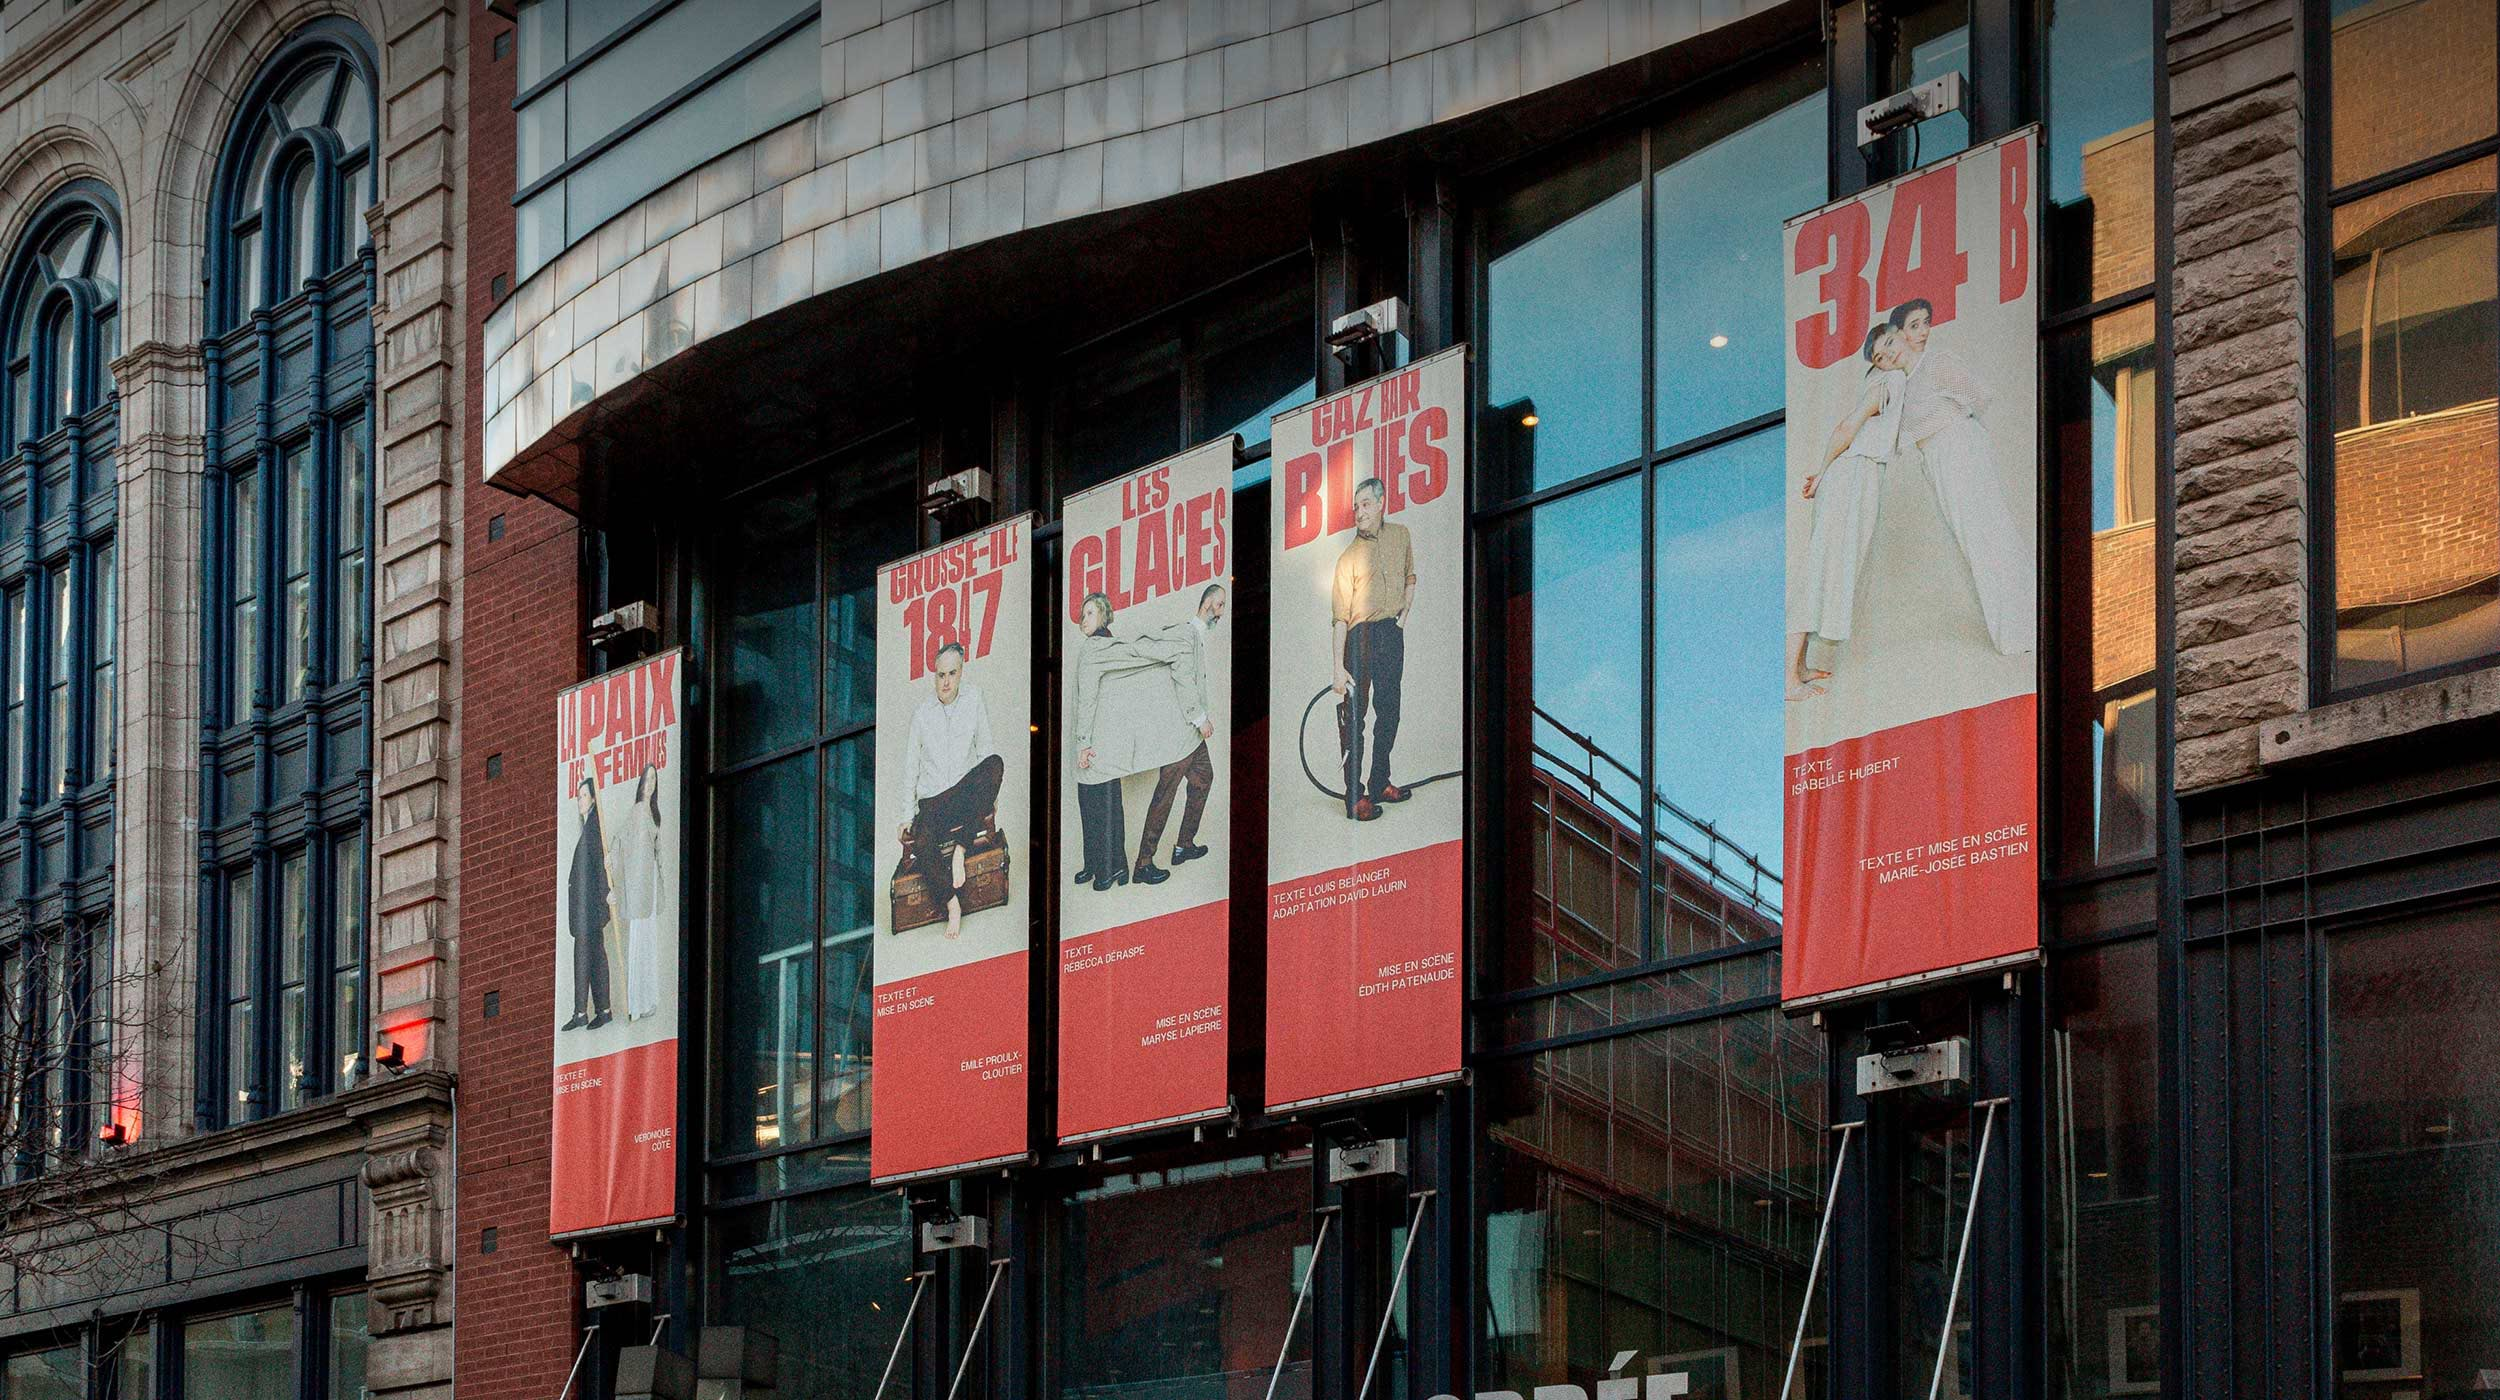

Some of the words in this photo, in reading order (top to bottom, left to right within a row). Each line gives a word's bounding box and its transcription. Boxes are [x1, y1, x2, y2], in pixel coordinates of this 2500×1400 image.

[1794, 163, 1969, 369] 34
[1999, 138, 2029, 305] B
[1311, 386, 1374, 448] GAZ
[1380, 368, 1421, 423] BAR
[1284, 406, 1449, 551] BLUES
[1122, 466, 1170, 522] LES
[1069, 487, 1226, 625] GLACES
[903, 568, 1003, 681] 1847
[560, 691, 577, 763] LA
[580, 654, 677, 755] PAIX
[568, 757, 585, 800] DES
[593, 729, 668, 791] FEMMES
[1791, 771, 1846, 796] ISABELLE
[1849, 756, 1901, 781] HUBERT
[1793, 758, 1833, 779] TEXTE
[1859, 851, 1903, 872] TEXTE
[1906, 846, 1925, 862] ET
[1928, 838, 1959, 857] MISE
[1962, 834, 1981, 849] EN
[1984, 823, 2029, 843] SCÈNE
[1879, 854, 1966, 885] MARIE-JOSÉE
[1970, 841, 2029, 866] BASTIEN
[1272, 895, 1337, 920] ADAPTATION
[1339, 888, 1370, 905] DAVID
[1372, 879, 1407, 897] LAURIN
[1273, 887, 1306, 905] TEXTE
[1309, 880, 1336, 897] LOUIS
[1064, 944, 1094, 960] TEXTE
[1378, 962, 1402, 978] MISE
[1404, 959, 1419, 973] EN
[1421, 952, 1456, 969] SCÈNE
[878, 990, 905, 1004] TEXTE
[905, 986, 918, 998] ET
[1358, 979, 1390, 998] ÉDITH
[1391, 968, 1455, 991] PATENAUDE
[876, 1005, 896, 1017] MISE
[896, 1002, 908, 1014] EN
[1156, 1014, 1177, 1030] MISE
[1178, 1011, 1191, 1025] EN
[1192, 1004, 1223, 1022] SCÈNE
[1141, 1029, 1178, 1048] MARYSE
[1180, 1019, 1222, 1039] LAPIERRE
[982, 1063, 1023, 1081] CLOUTIER
[985, 1050, 1023, 1066] PROULX-
[556, 1070, 577, 1083] TEXTE
[578, 1068, 587, 1079] ET
[570, 1082, 580, 1092] EN
